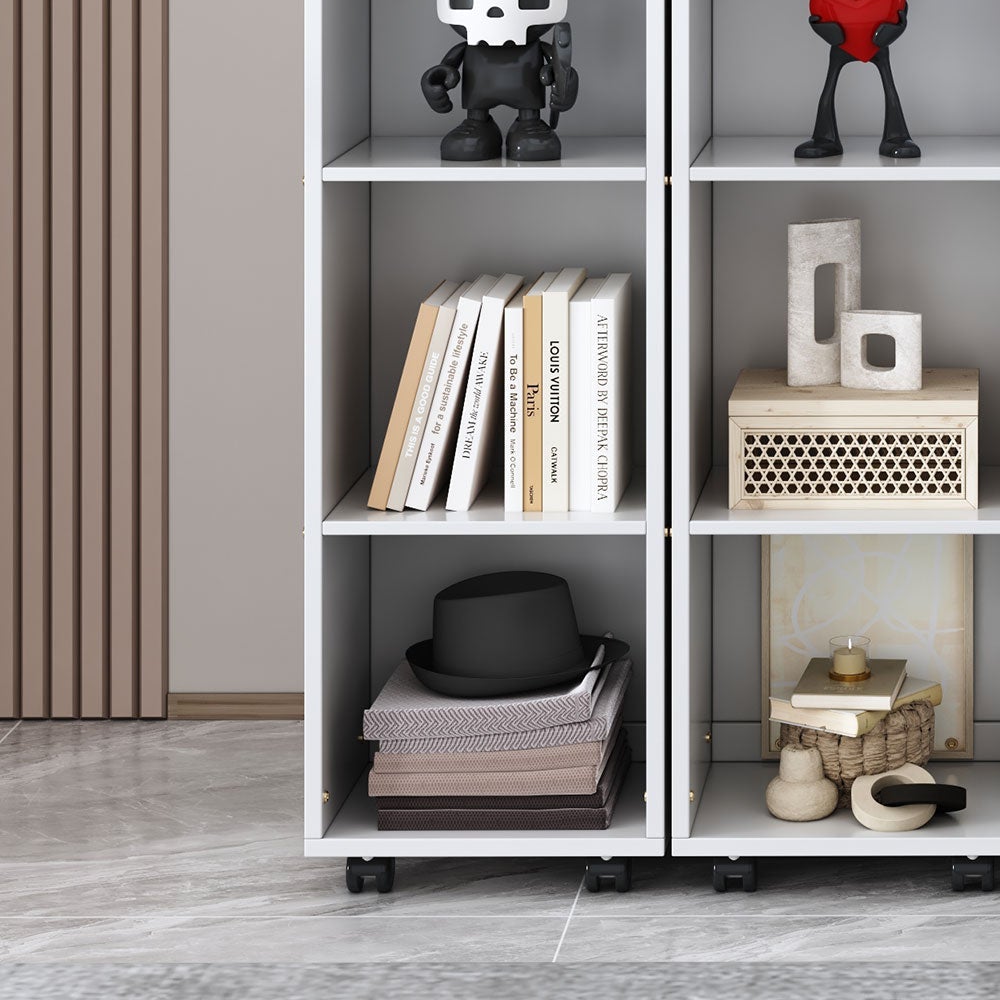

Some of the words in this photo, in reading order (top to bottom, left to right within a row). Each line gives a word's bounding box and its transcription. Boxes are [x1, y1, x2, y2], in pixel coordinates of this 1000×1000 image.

[509, 354, 518, 365] To
[550, 341, 560, 373] LOUIS
[597, 314, 608, 386] AFTERWORD
[426, 352, 440, 383] GUIDE
[431, 422, 442, 434] for
[440, 360, 458, 411] sustainable
[452, 323, 468, 358] lifestyle
[509, 368, 518, 382] Be
[417, 385, 430, 414] GOOD
[462, 421, 476, 459] DREAM
[470, 409, 478, 420] the
[475, 351, 488, 388] AWAKE
[526, 384, 540, 417] Paris
[550, 377, 560, 423] VUITTON
[597, 389, 608, 404] BY
[415, 416, 423, 425] A
[509, 393, 518, 433] Machine
[597, 408, 608, 450] DEEPAK
[412, 425, 420, 435] IS
[405, 436, 416, 457] THIS
[597, 455, 608, 501] CHOPRA
